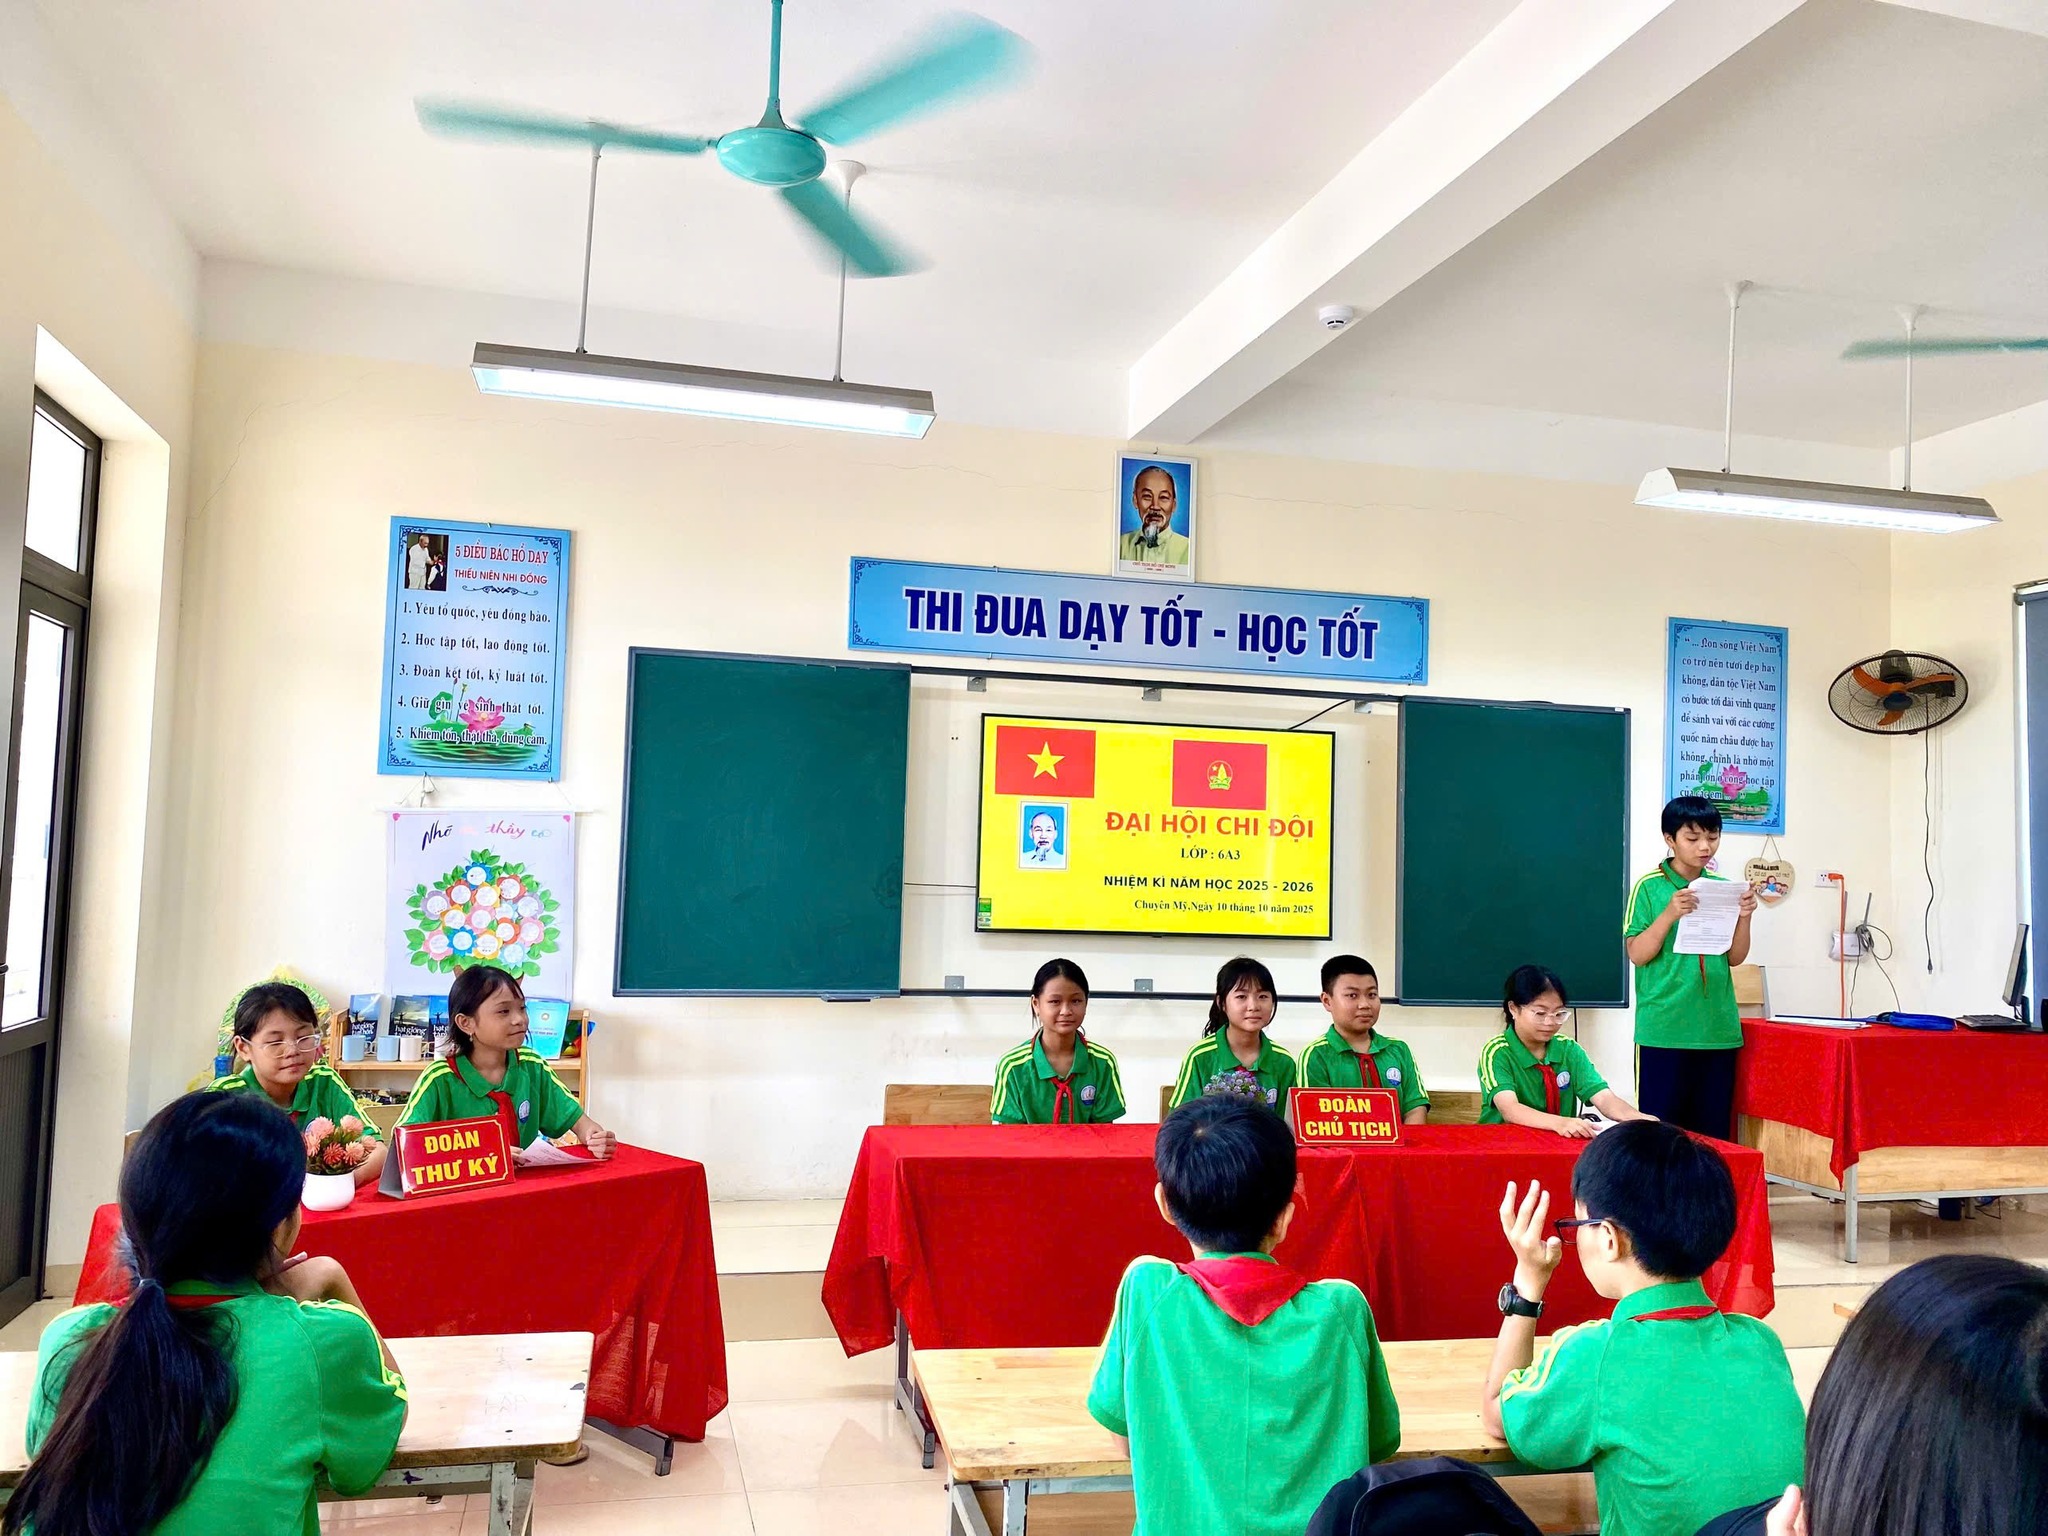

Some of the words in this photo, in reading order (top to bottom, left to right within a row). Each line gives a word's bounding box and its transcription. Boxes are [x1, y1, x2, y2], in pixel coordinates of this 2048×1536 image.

[455, 546, 461, 557] 5
[490, 543, 509, 561] BÁC
[528, 550, 548, 566] DẠY
[455, 567, 478, 579] THIẾU
[480, 569, 500, 581] NIÊN
[502, 573, 518, 582] NHI
[403, 601, 412, 614] 1.
[416, 602, 435, 615] Yêu
[438, 602, 449, 616] tổ
[451, 604, 479, 620] quốc,
[481, 607, 499, 621] yêu
[529, 609, 551, 623] bào.
[905, 588, 963, 632] THI
[974, 593, 1047, 638] ĐUA
[1059, 600, 1130, 651] DẠY
[1140, 594, 1203, 648] TỐT
[1213, 629, 1226, 638] -
[1238, 612, 1307, 663] HỌC
[1318, 606, 1379, 659] TỐT
[401, 632, 410, 645] 2.
[415, 633, 436, 649] Học
[440, 635, 457, 651] tập
[461, 636, 479, 650] tốt,
[484, 637, 499, 650] lao
[503, 639, 528, 656] động
[533, 640, 550, 653] tốt.
[1700, 637, 1718, 649] Non
[1719, 639, 1738, 651] sông
[1740, 640, 1757, 654] Việt
[1758, 642, 1777, 654] Nam
[399, 663, 409, 676] 3.
[413, 664, 441, 678] Đoàn
[445, 665, 461, 679] kết
[466, 666, 484, 681] tốt,
[506, 669, 525, 685] luật
[531, 671, 548, 684] tốt.
[1682, 656, 1692, 666] có
[1693, 656, 1707, 667] trở
[1708, 658, 1724, 669] nên
[1726, 660, 1743, 670] tươi
[1744, 661, 1760, 674] đẹp
[1761, 662, 1777, 674] hay
[1681, 673, 1709, 688] không,
[1710, 676, 1725, 688] dân
[1727, 678, 1739, 691] tộc
[1740, 678, 1757, 693] Việt
[1758, 680, 1776, 692] Nam
[397, 695, 407, 707] 4.
[411, 695, 430, 709] Giữ
[435, 697, 451, 711] gìn
[475, 699, 495, 712] sinh
[502, 701, 522, 716] thật
[528, 702, 544, 715] tốt.
[1681, 693, 1691, 704] có
[1691, 694, 1710, 705] bước
[1711, 695, 1721, 706] tới
[1722, 696, 1734, 707] đài
[1735, 698, 1752, 709] vinh
[1753, 700, 1776, 712] quang
[1680, 710, 1691, 723] để
[1692, 713, 1710, 725] sánh
[1712, 715, 1724, 726] vai
[1725, 716, 1737, 727] với
[1738, 717, 1752, 728] các
[1752, 718, 1775, 731] cường
[396, 726, 404, 738] 5.
[410, 726, 440, 740] Khiêm
[442, 728, 460, 743] tốn,
[462, 728, 480, 744] thật
[482, 730, 500, 744] thà,
[502, 731, 524, 746] dũng
[526, 731, 548, 745] cảm.
[1680, 731, 1700, 743] quốc
[1701, 734, 1719, 745] năm
[1720, 734, 1739, 746] châu
[1740, 735, 1760, 749] được
[1761, 737, 1775, 750] hay
[1680, 750, 1708, 763] không,
[1733, 754, 1741, 765] là
[1743, 755, 1759, 767] nhờ
[1759, 757, 1775, 769] một
[1680, 769, 1701, 783] phần
[1724, 773, 1745, 785] công
[1746, 774, 1760, 787] học
[1761, 776, 1775, 788] tập
[1680, 785, 1693, 797] của
[1694, 786, 1710, 799] các
[1710, 792, 1723, 800] em
[1105, 811, 1150, 837] ĐẠI
[1161, 810, 1206, 839] HỘI
[1216, 816, 1259, 836] CHI
[1268, 814, 1313, 843] ĐỘI
[1181, 844, 1208, 859] LỚP
[1218, 849, 1241, 860] 6A3
[1104, 874, 1148, 890] NHIỆM
[1152, 875, 1165, 888] KÌ
[1170, 875, 1200, 889] NĂM
[1205, 879, 1233, 892] HỌC
[1237, 879, 1269, 891] 2025
[1282, 881, 1314, 892] 2026
[1134, 899, 1170, 912] Chuyên
[1217, 902, 1228, 911] 10
[1229, 902, 1256, 913] tháng
[1258, 903, 1269, 912] 10
[1271, 904, 1291, 913] năm
[1293, 904, 1314, 914] 2025
[1318, 1095, 1372, 1113] ĐOÀN
[1305, 1116, 1344, 1137] CHỦ
[1349, 1121, 1392, 1140] TỊCH
[424, 1128, 481, 1154] ĐOÀN
[411, 1159, 463, 1185] THƯ
[468, 1152, 499, 1177] KÝ
